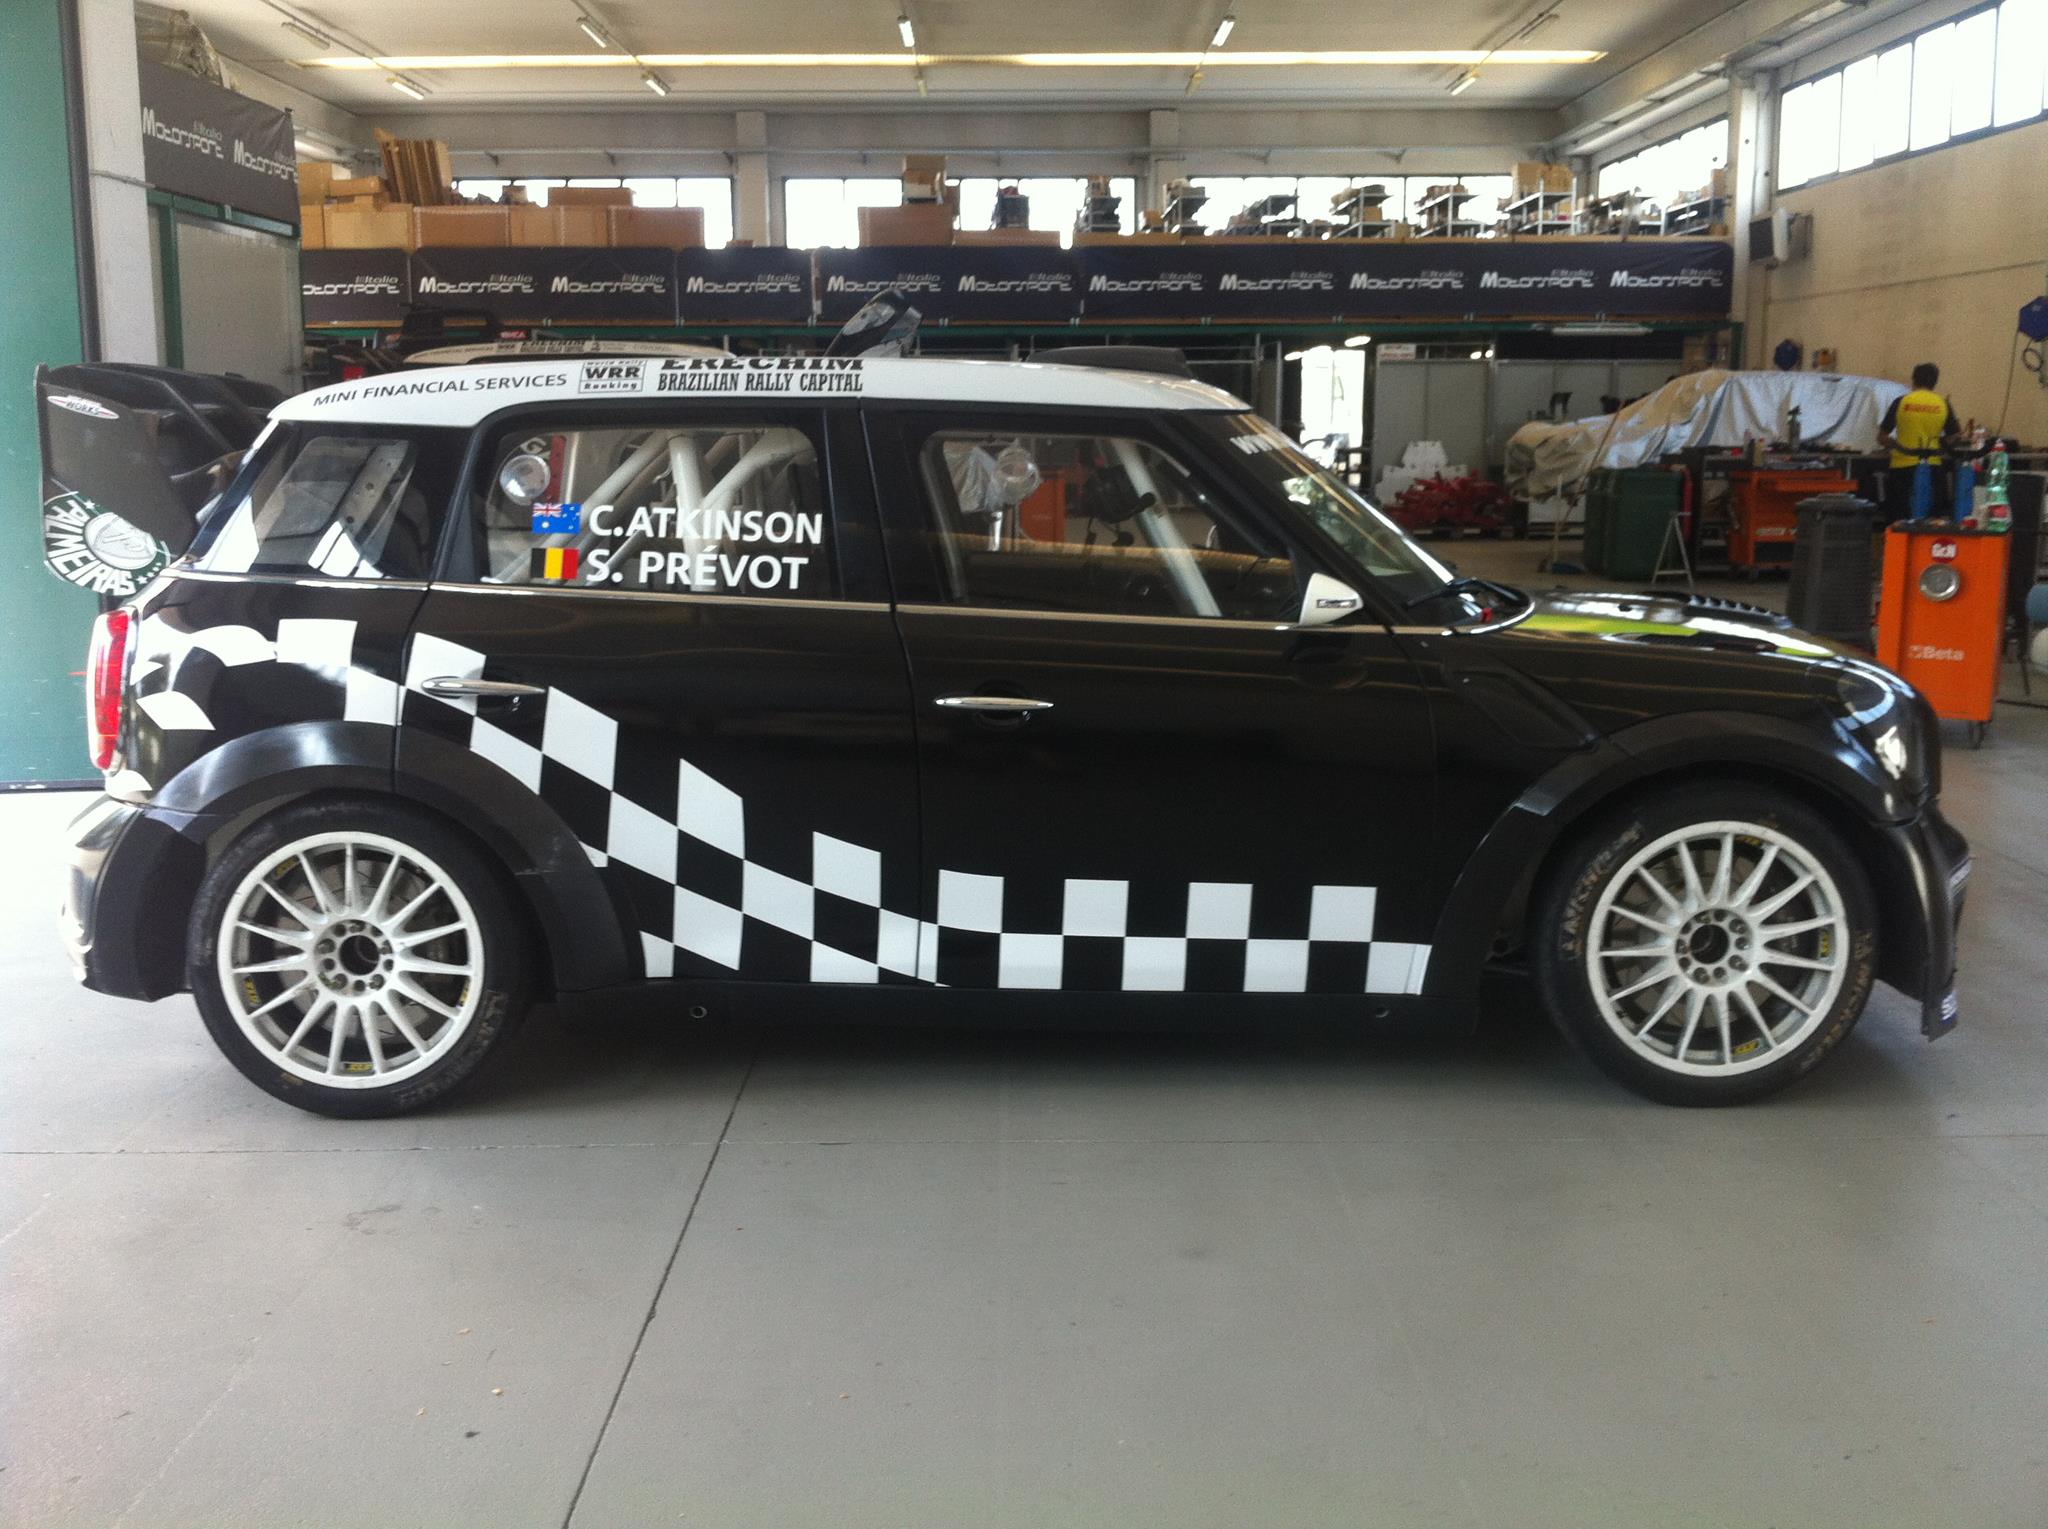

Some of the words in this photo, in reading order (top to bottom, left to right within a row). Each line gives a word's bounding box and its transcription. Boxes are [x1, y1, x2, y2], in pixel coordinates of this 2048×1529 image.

[142, 106, 225, 160] Motorsport
[303, 283, 400, 295] otorsport
[583, 380, 638, 391] Ranking
[585, 366, 641, 379] WRR
[657, 372, 740, 391] BRAZILIAN
[745, 373, 794, 391] RALLY
[799, 372, 864, 392] CAPITAL
[313, 389, 358, 406] MINI
[363, 379, 469, 400] FINANCIAL
[474, 373, 568, 391] SERVICES
[43, 499, 137, 597] PALMEIRAS
[586, 549, 624, 583] S.
[638, 545, 809, 589] PRÉVOT
